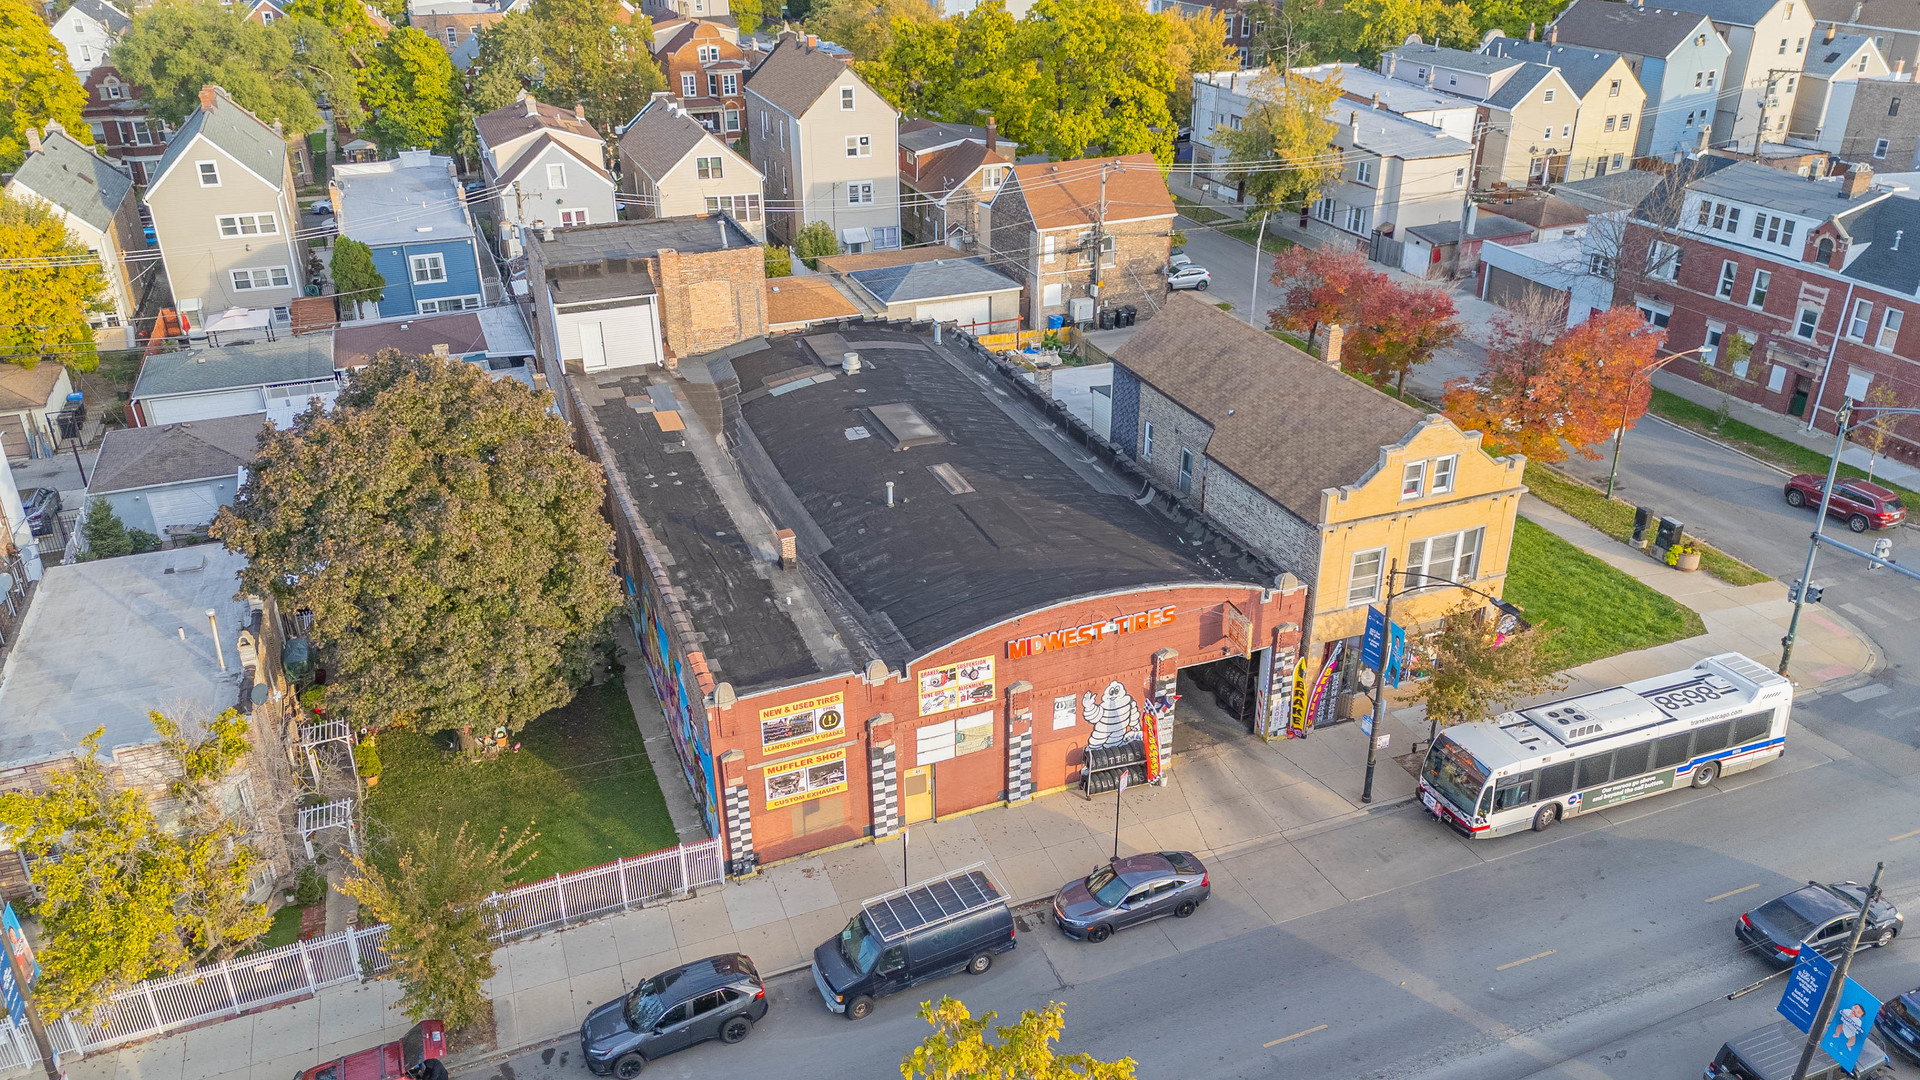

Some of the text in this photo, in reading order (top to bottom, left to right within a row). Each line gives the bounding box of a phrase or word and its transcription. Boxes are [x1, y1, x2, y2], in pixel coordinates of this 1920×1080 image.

[1008, 605, 1176, 660] MIDWEST TIRES
[920, 669, 939, 678] BRAKES
[956, 660, 986, 670] SUSPENSION
[958, 681, 985, 692] ALIGNMENT
[920, 692, 934, 700] TUNE
[1293, 680, 1305, 725] BRAKE
[1654, 686, 1721, 710] 8658
[763, 708, 782, 718] NEW
[792, 700, 815, 711] USED
[816, 694, 841, 706] TIRES
[1690, 709, 1743, 726] transitchicago.com
[764, 740, 791, 752] LLANTAS
[792, 736, 815, 746] NUEVAS
[820, 730, 844, 740] USADAS
[767, 750, 843, 774] MUFFLER SHOP
[1108, 752, 1141, 764] TIRES
[1102, 772, 1144, 788] LLATAS
[1602, 786, 1612, 794] Our
[1640, 776, 1656, 784] above
[774, 786, 841, 806] CUSTOM EXHAUST
